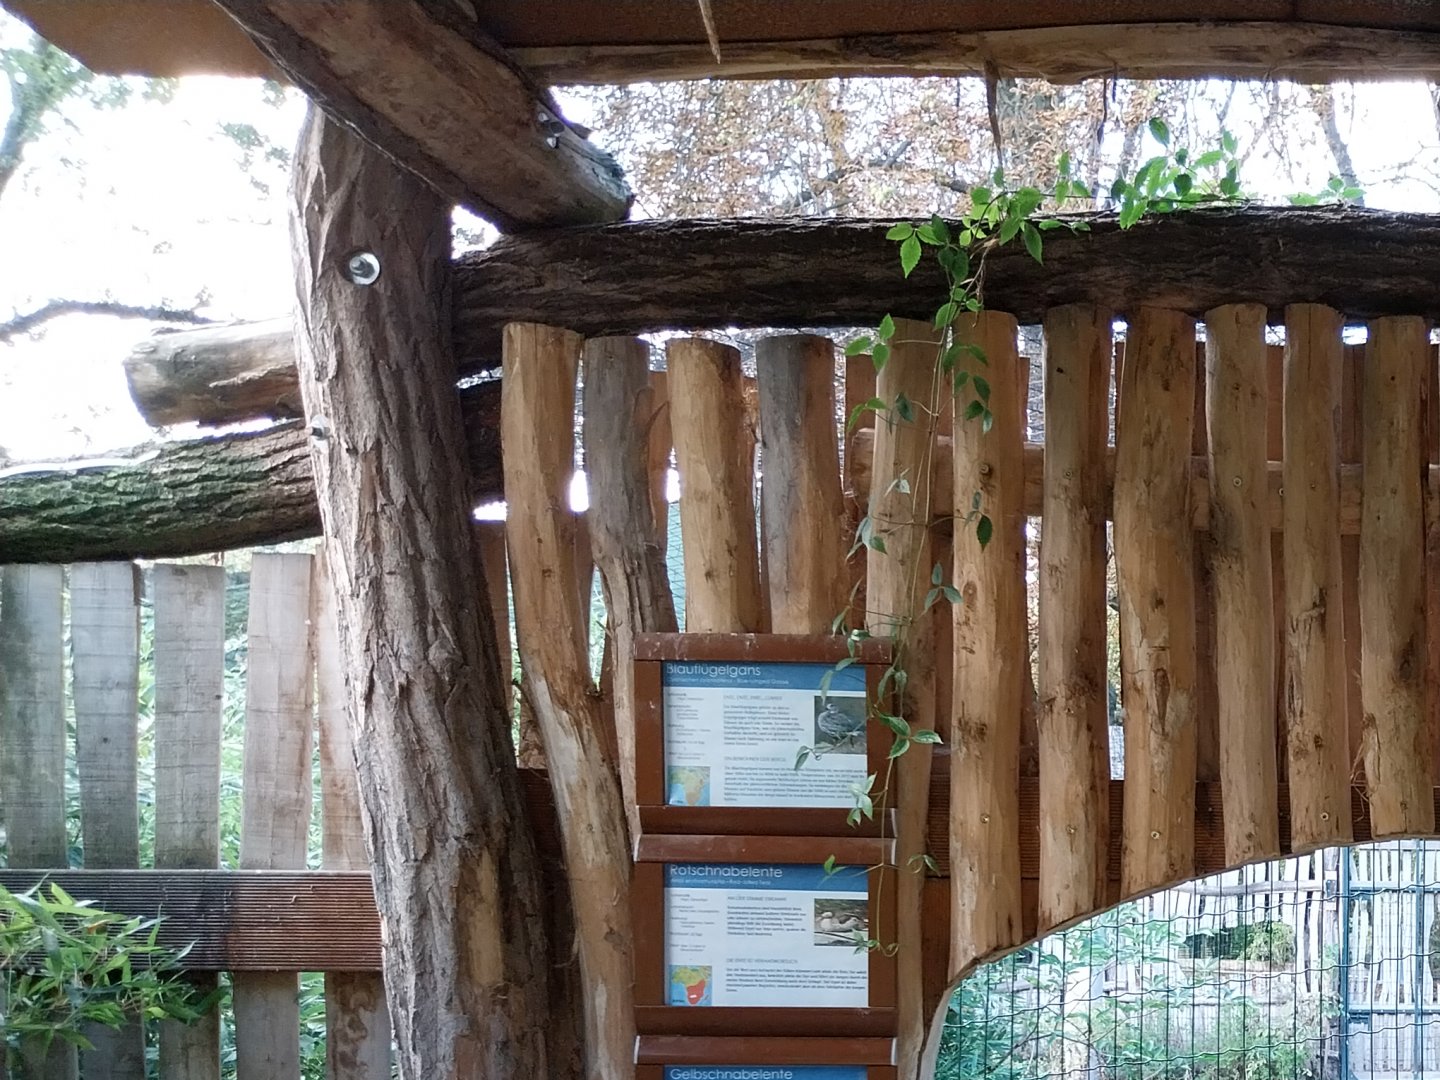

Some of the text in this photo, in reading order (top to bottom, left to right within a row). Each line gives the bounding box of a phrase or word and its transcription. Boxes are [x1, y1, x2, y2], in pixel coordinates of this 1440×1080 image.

[667, 663, 761, 678] Blauflügelgans
[670, 865, 783, 878] Rotschnabelente
[670, 1068, 793, 1080] Gelbschnabelente
